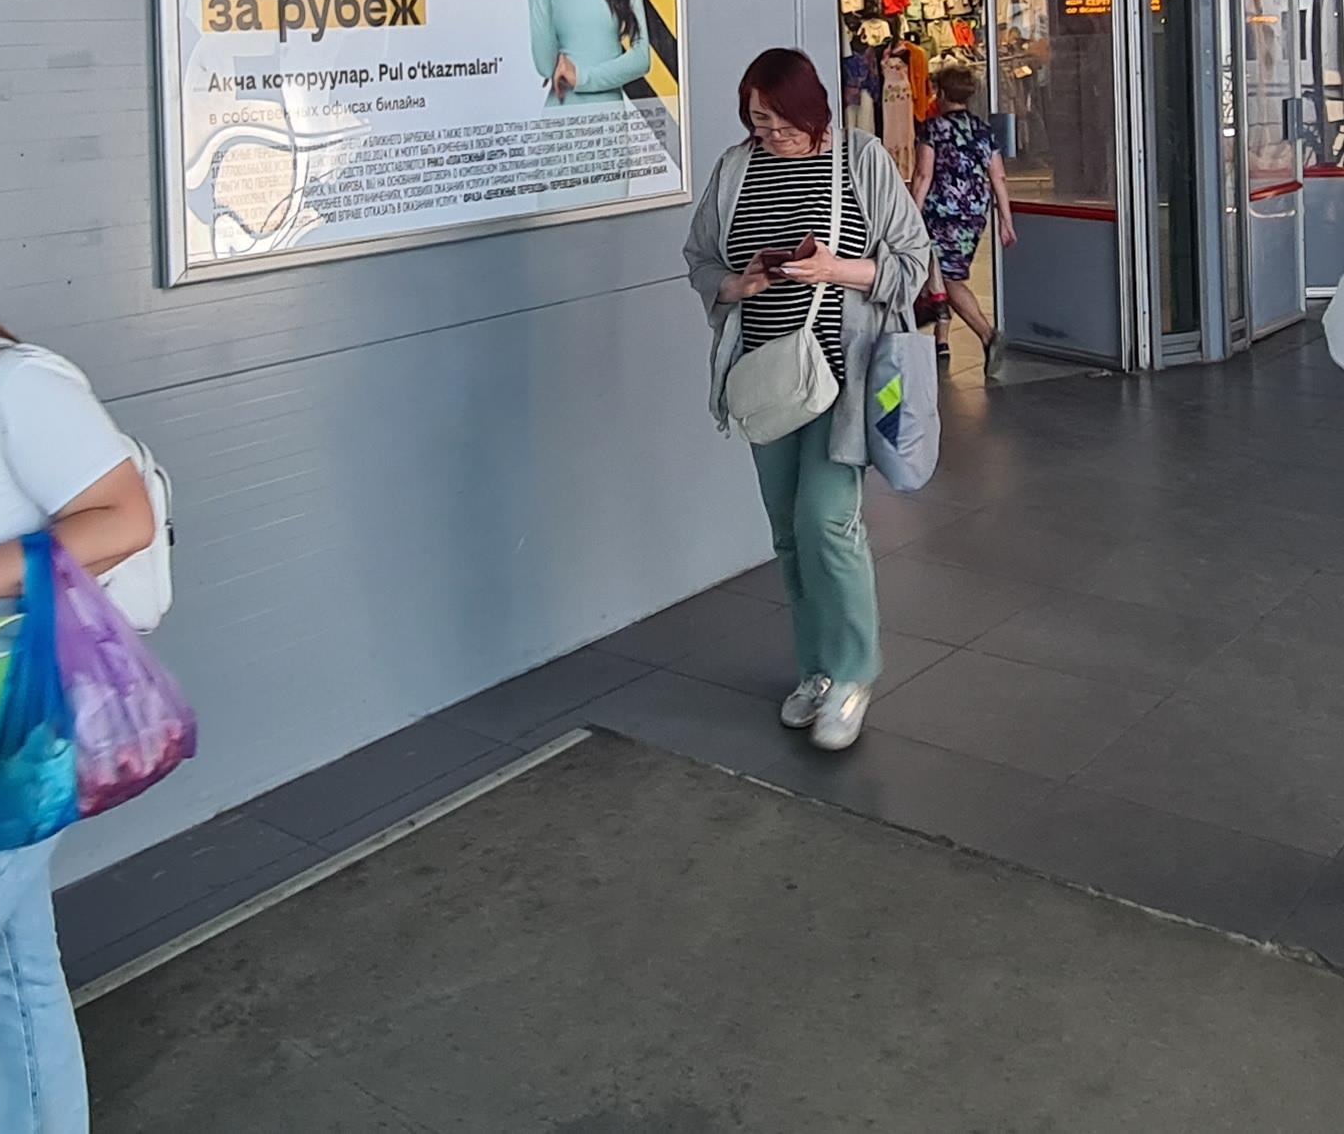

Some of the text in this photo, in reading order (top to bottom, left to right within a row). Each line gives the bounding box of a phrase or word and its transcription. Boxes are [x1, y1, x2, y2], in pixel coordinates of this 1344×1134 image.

[208, 66, 375, 92] Акча которуулар.
[379, 61, 404, 83] Pul
[222, 104, 318, 124] собственых
[322, 101, 373, 117] офисах
[376, 95, 426, 112] билайна
